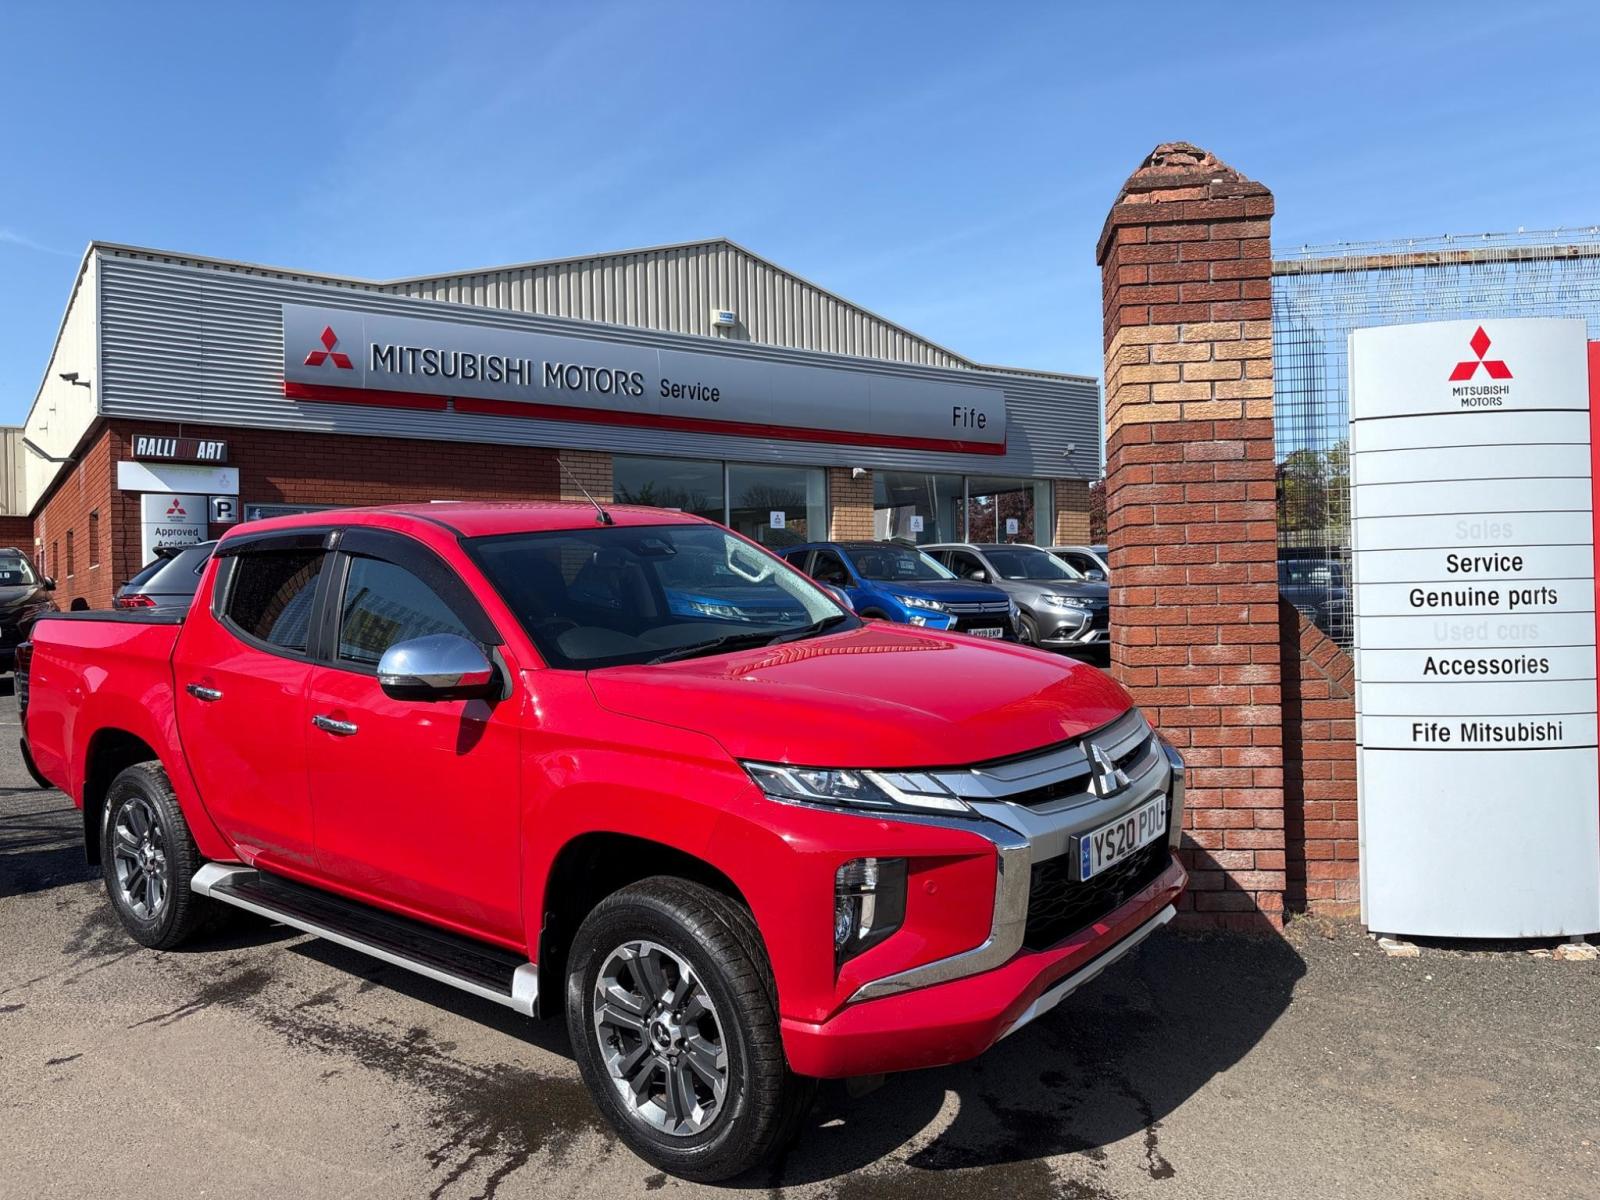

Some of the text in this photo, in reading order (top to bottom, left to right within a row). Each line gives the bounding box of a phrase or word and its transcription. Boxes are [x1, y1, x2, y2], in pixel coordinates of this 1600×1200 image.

[370, 342, 720, 402] MITSUBISHI MOTORS Service
[1452, 385, 1510, 397] MITSUBISHI
[1461, 396, 1503, 407] MOTORS
[953, 406, 987, 429] Fife
[136, 438, 225, 460] RALLI ART
[217, 501, 232, 518] P
[155, 527, 199, 537] Approved
[1455, 520, 1513, 541] Sales
[1446, 553, 1524, 573] Service
[1409, 586, 1558, 610] Genuine parts
[1433, 621, 1539, 642] Used cars
[1423, 655, 1550, 675] Accessories
[1412, 721, 1563, 742] Fife Mitsubishi
[1094, 818, 1136, 867] YS20
[1139, 800, 1164, 843] PDU
